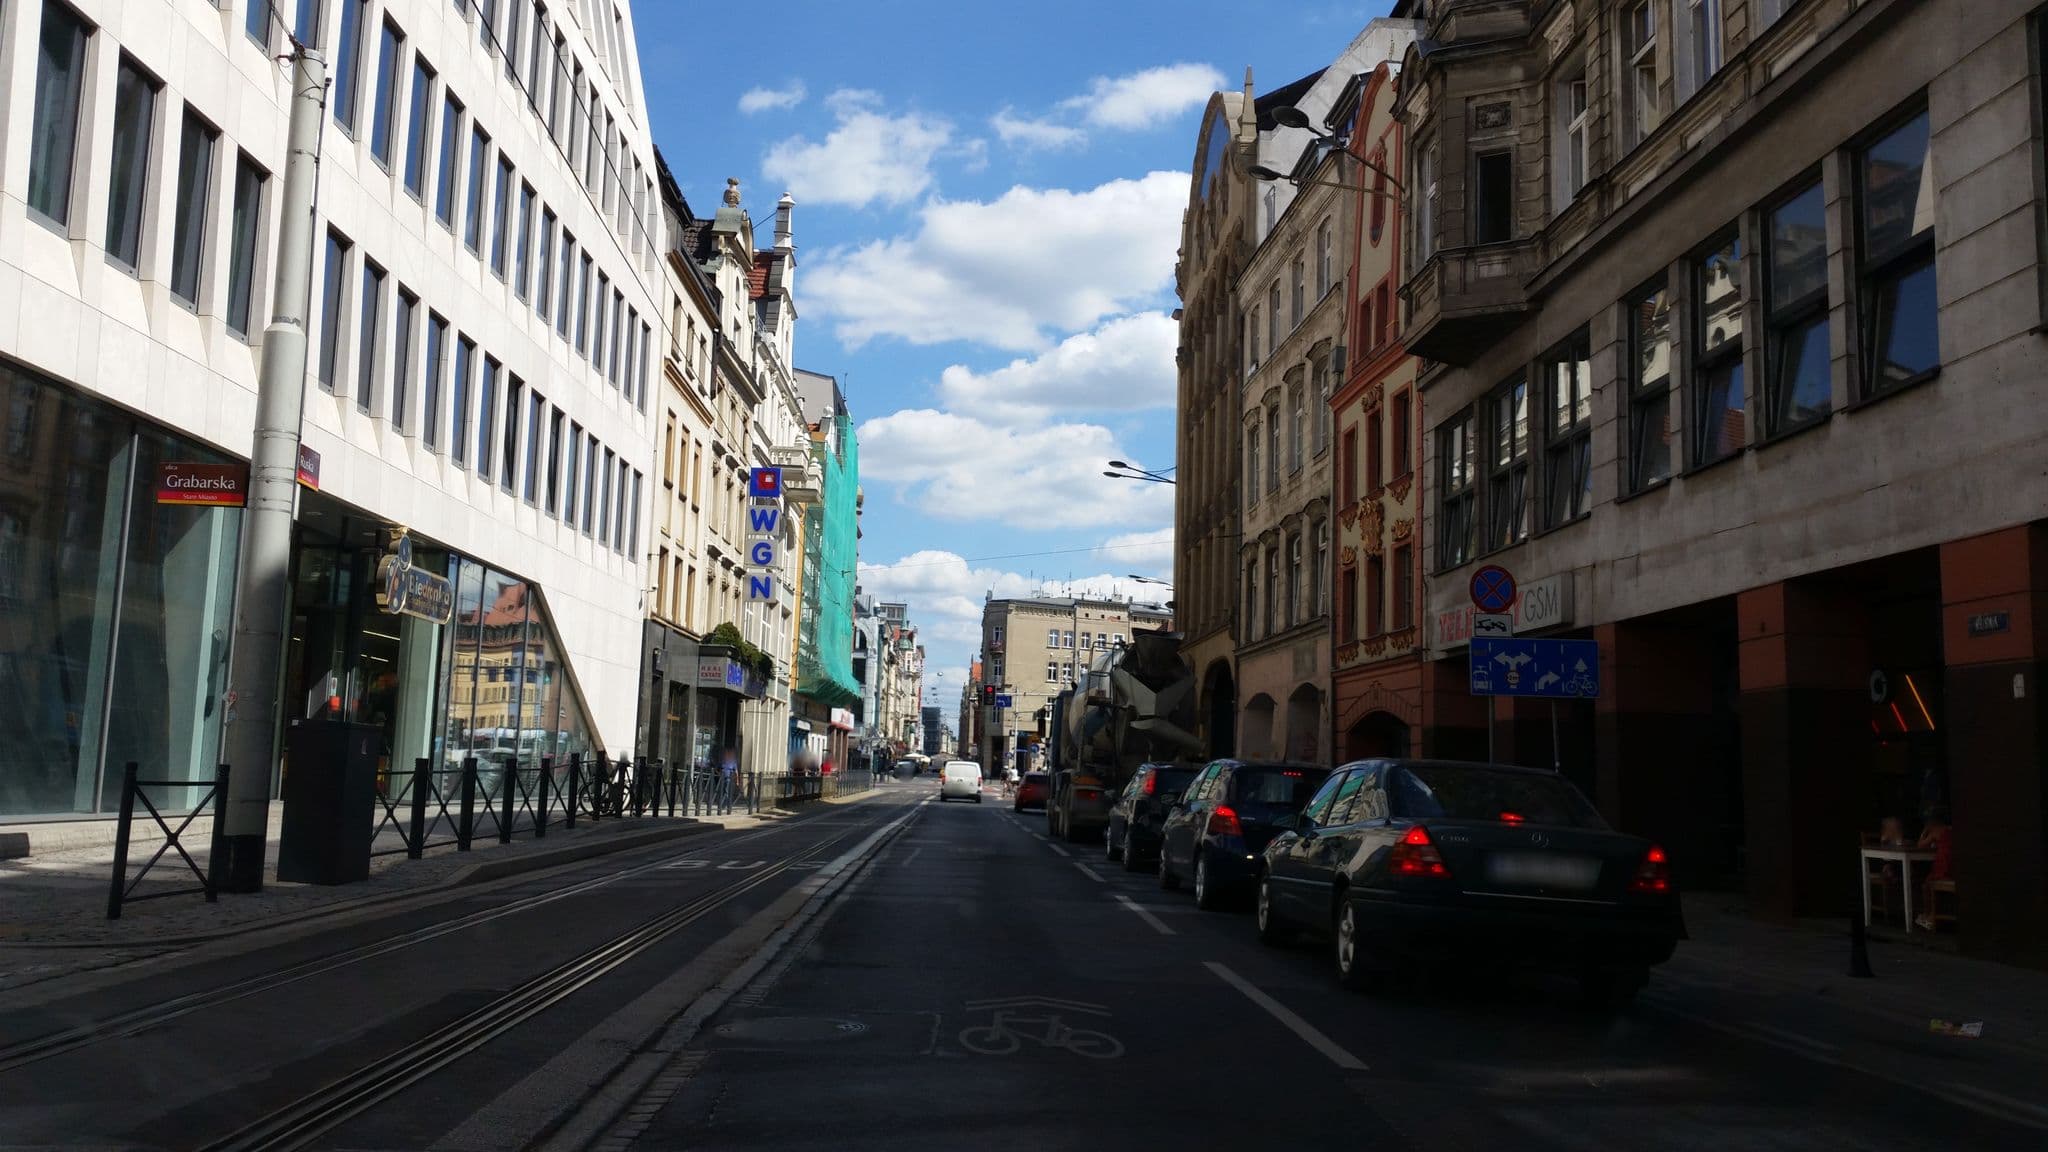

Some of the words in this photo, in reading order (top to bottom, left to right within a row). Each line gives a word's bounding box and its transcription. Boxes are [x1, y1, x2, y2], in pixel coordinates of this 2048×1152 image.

[166, 474, 236, 490] Grabarska
[750, 508, 778, 599] WGN
[1525, 586, 1557, 622] GSM
